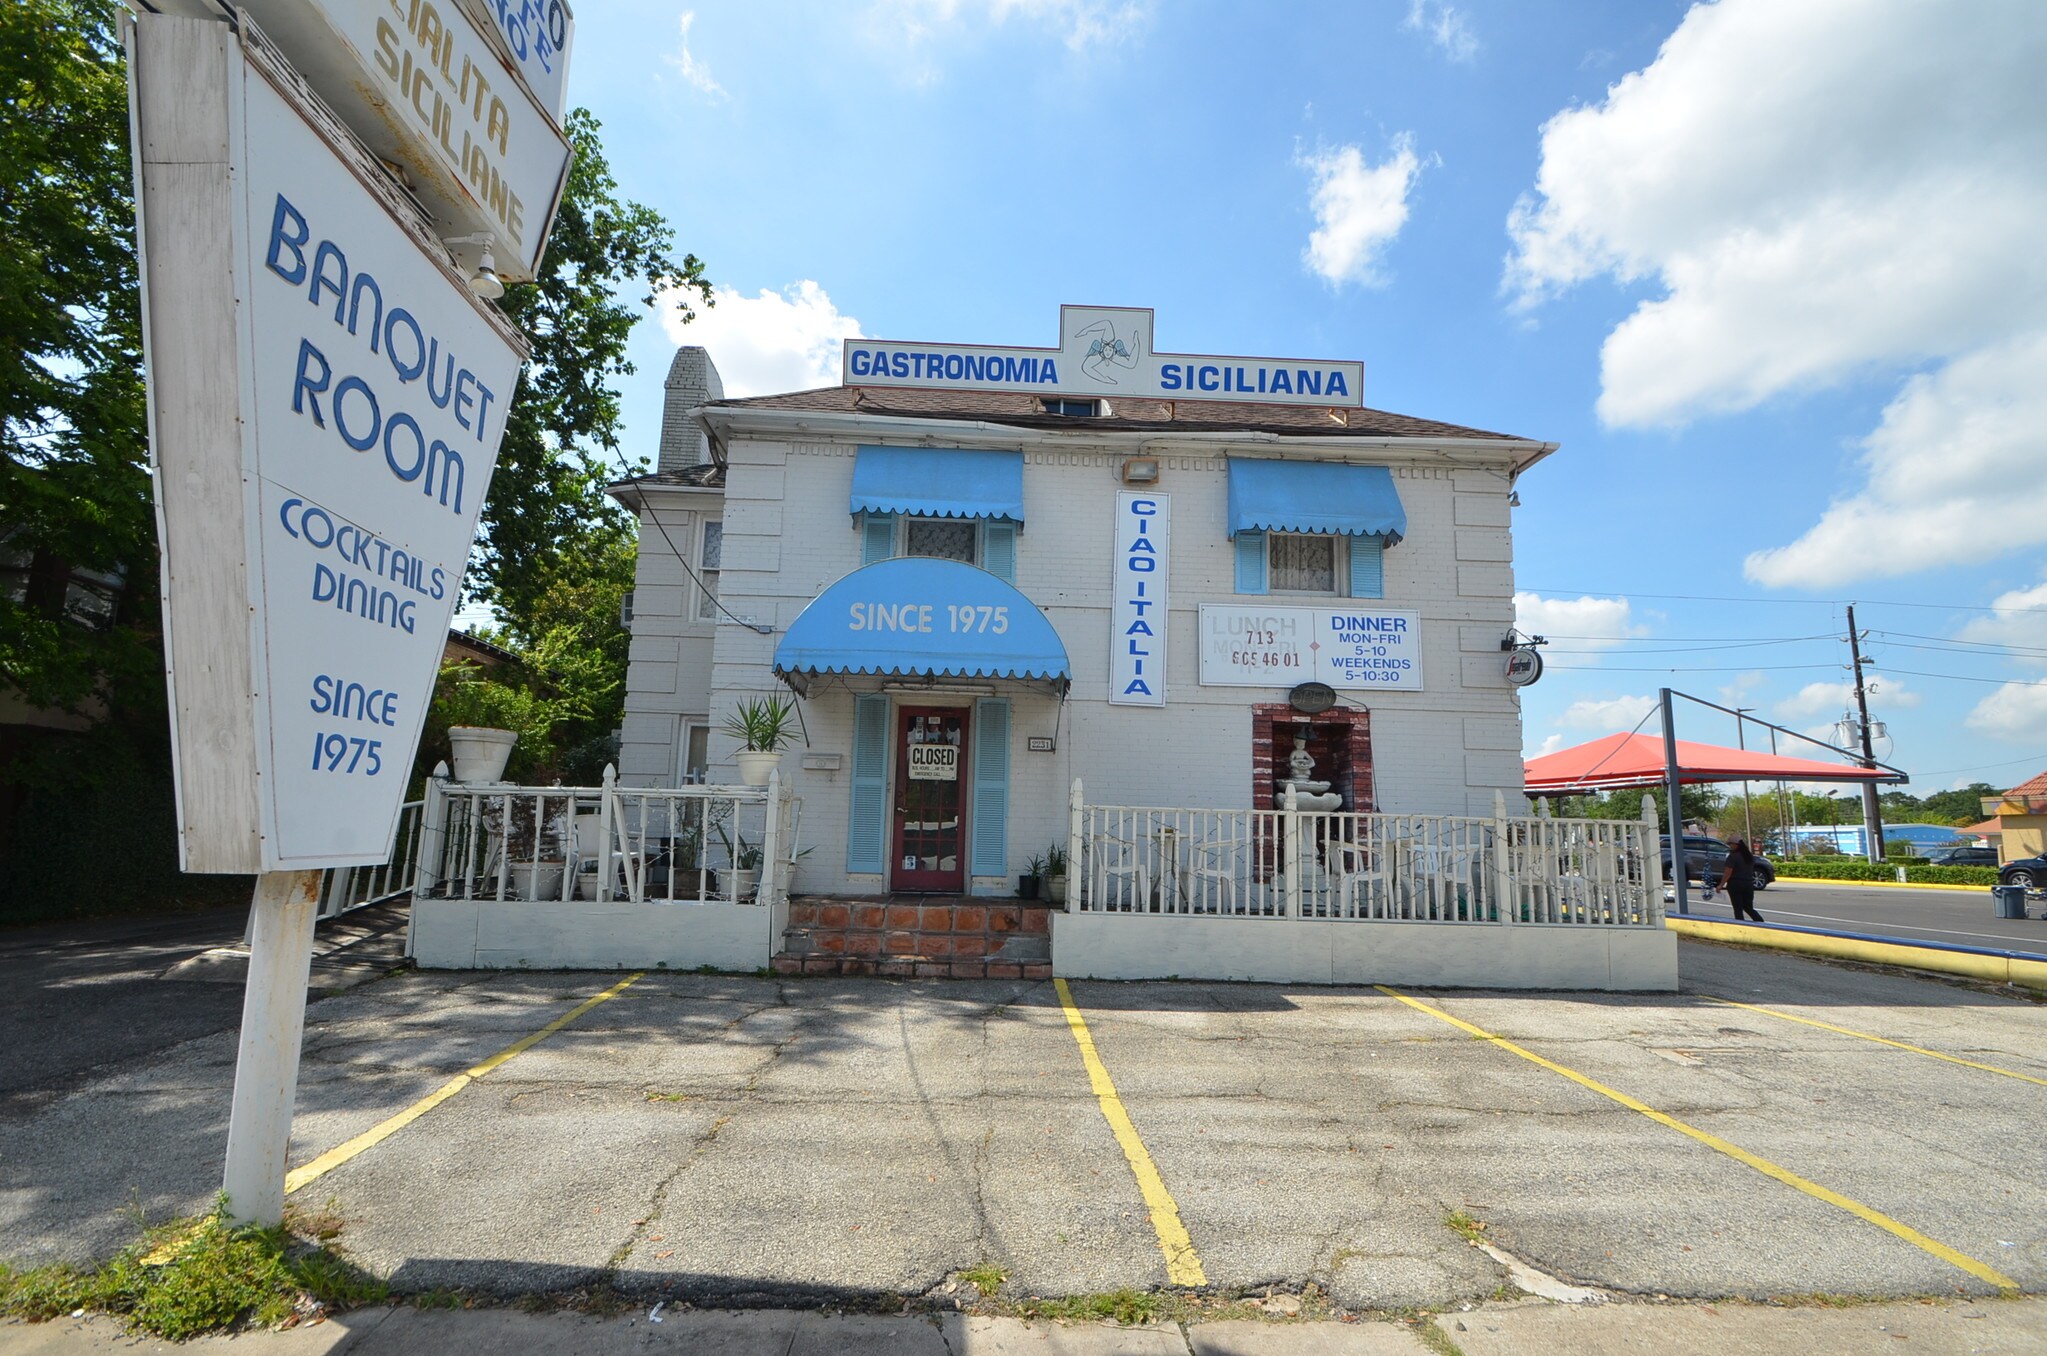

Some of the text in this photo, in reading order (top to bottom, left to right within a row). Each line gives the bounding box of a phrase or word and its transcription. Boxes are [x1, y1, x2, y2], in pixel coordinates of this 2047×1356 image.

[388, 0, 510, 157] IALITA
[374, 16, 524, 247] SICILIANE
[266, 193, 495, 443] BANQUET
[851, 349, 1350, 397] GASTRONOMIA SICILIANA
[291, 337, 465, 516] ROOM
[280, 498, 446, 600] COCKTAILS
[312, 563, 417, 634] DINING
[849, 602, 1009, 634] SINCE 1975
[1123, 500, 1157, 696] CIAO ITALIA
[1212, 616, 1297, 637] LUNCH
[1246, 630, 1275, 645] 713
[1331, 616, 1407, 632] DINNER
[1339, 633, 1401, 644] MON-FRI
[1331, 657, 1411, 669] WEEKENDS
[1355, 645, 1387, 656] 5-10
[1345, 670, 1400, 681] 5-10:30
[310, 674, 399, 726] SINCE
[312, 732, 383, 776] 1975
[912, 747, 955, 766] CLOSED
